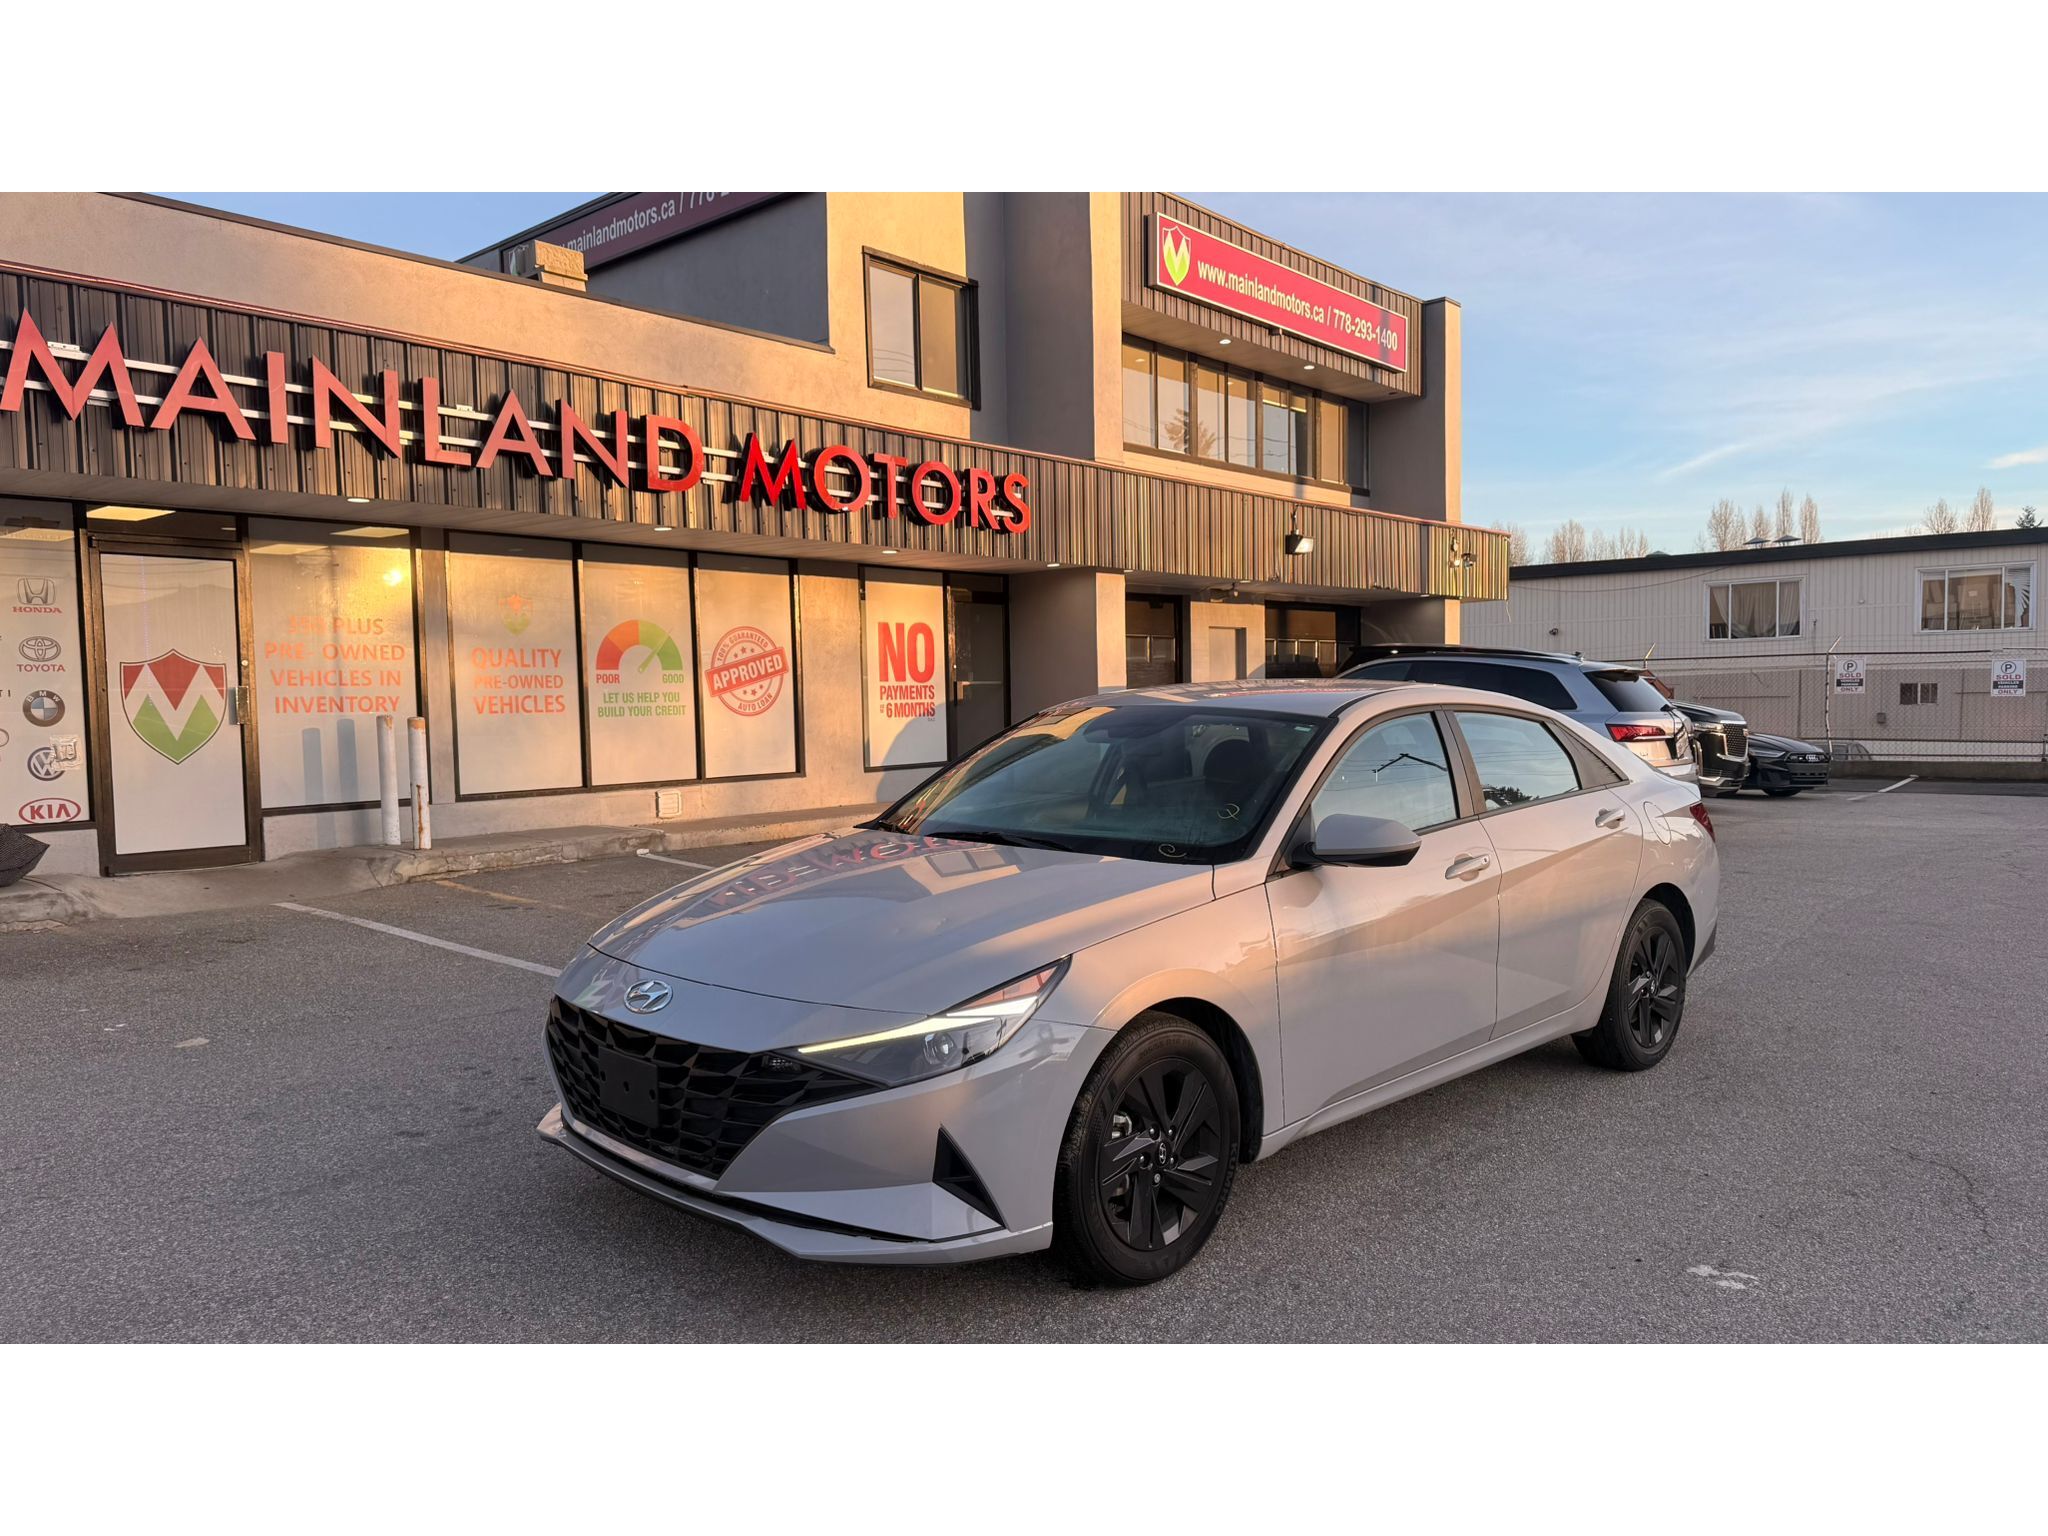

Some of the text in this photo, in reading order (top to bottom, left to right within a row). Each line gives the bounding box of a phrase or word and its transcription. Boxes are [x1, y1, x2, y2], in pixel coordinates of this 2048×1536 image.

[563, 199, 676, 252] mainlandmotors.ca
[1197, 260, 1398, 351] www.mainlandmotors.ca / 778-293-1400
[0, 307, 1031, 535] MAINLAND MOTORS
[12, 606, 63, 614] HONDA
[332, 617, 384, 635] PLUS
[728, 631, 769, 649] GUARANTEED
[322, 643, 405, 660] OWNED
[471, 647, 562, 670] QUALITY
[878, 622, 935, 683] NO
[16, 664, 65, 673] TOYOTA
[712, 654, 783, 691] APPROVED
[271, 669, 402, 687] VEHICLES IN
[474, 674, 564, 690] PRE-OWNED
[596, 674, 620, 684] POOR
[662, 673, 684, 684] GOOD
[603, 692, 680, 704] LET US HELP YOU
[738, 692, 773, 711] AUTO LOAN
[880, 685, 935, 700] PAYMENTS
[275, 695, 400, 714] INVENTORY
[473, 694, 566, 714] VEHICLES
[598, 704, 686, 717] BUILD YOUR CREDIT
[886, 702, 893, 718] 6
[894, 701, 935, 718] MONTHS
[30, 803, 71, 820] KIA
